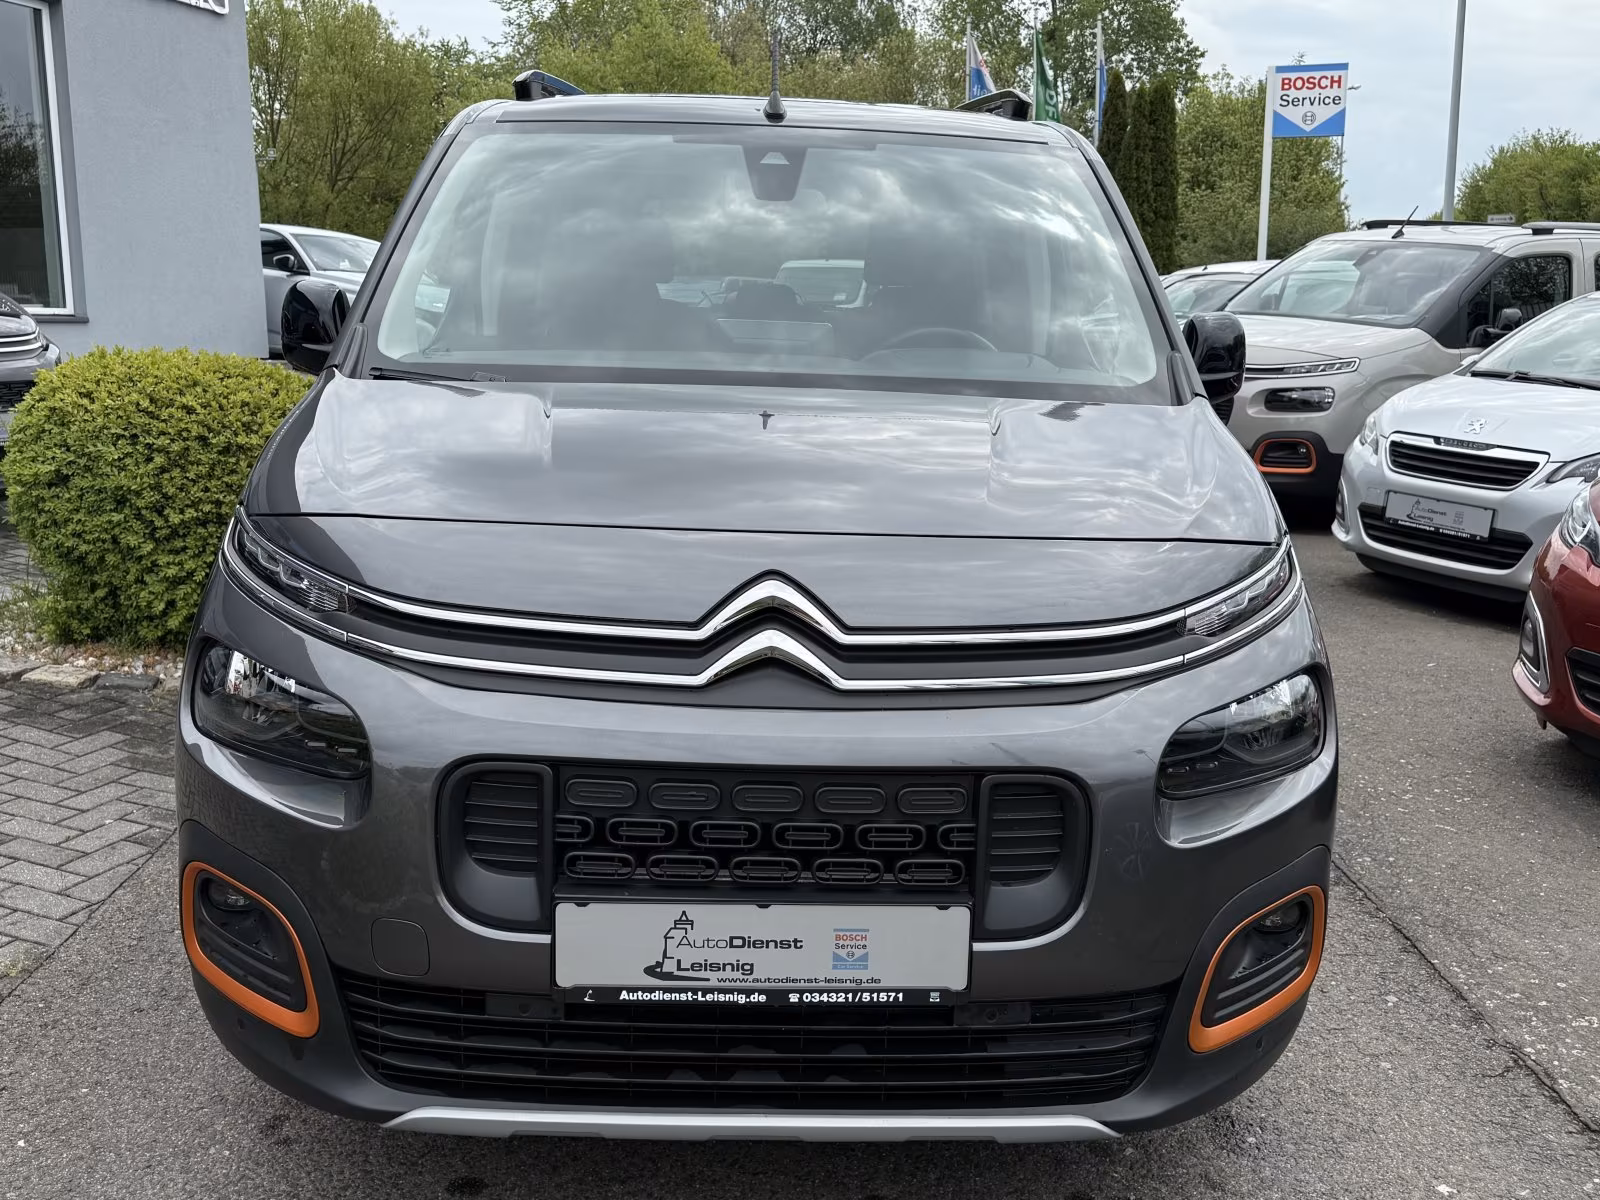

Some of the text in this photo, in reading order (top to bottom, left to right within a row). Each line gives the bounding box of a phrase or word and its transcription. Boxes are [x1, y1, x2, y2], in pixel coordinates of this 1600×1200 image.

[1281, 75, 1342, 91] BOSCH
[1279, 93, 1342, 107] Service
[676, 935, 804, 950] AutoDienst
[835, 934, 868, 942] BOSCH
[834, 942, 868, 950] Service
[676, 959, 755, 976] Leisnig
[716, 975, 882, 985] www.autodienst-leisnig.de
[619, 990, 904, 1004] Autodienst-Leisnig.de 034321/51571
